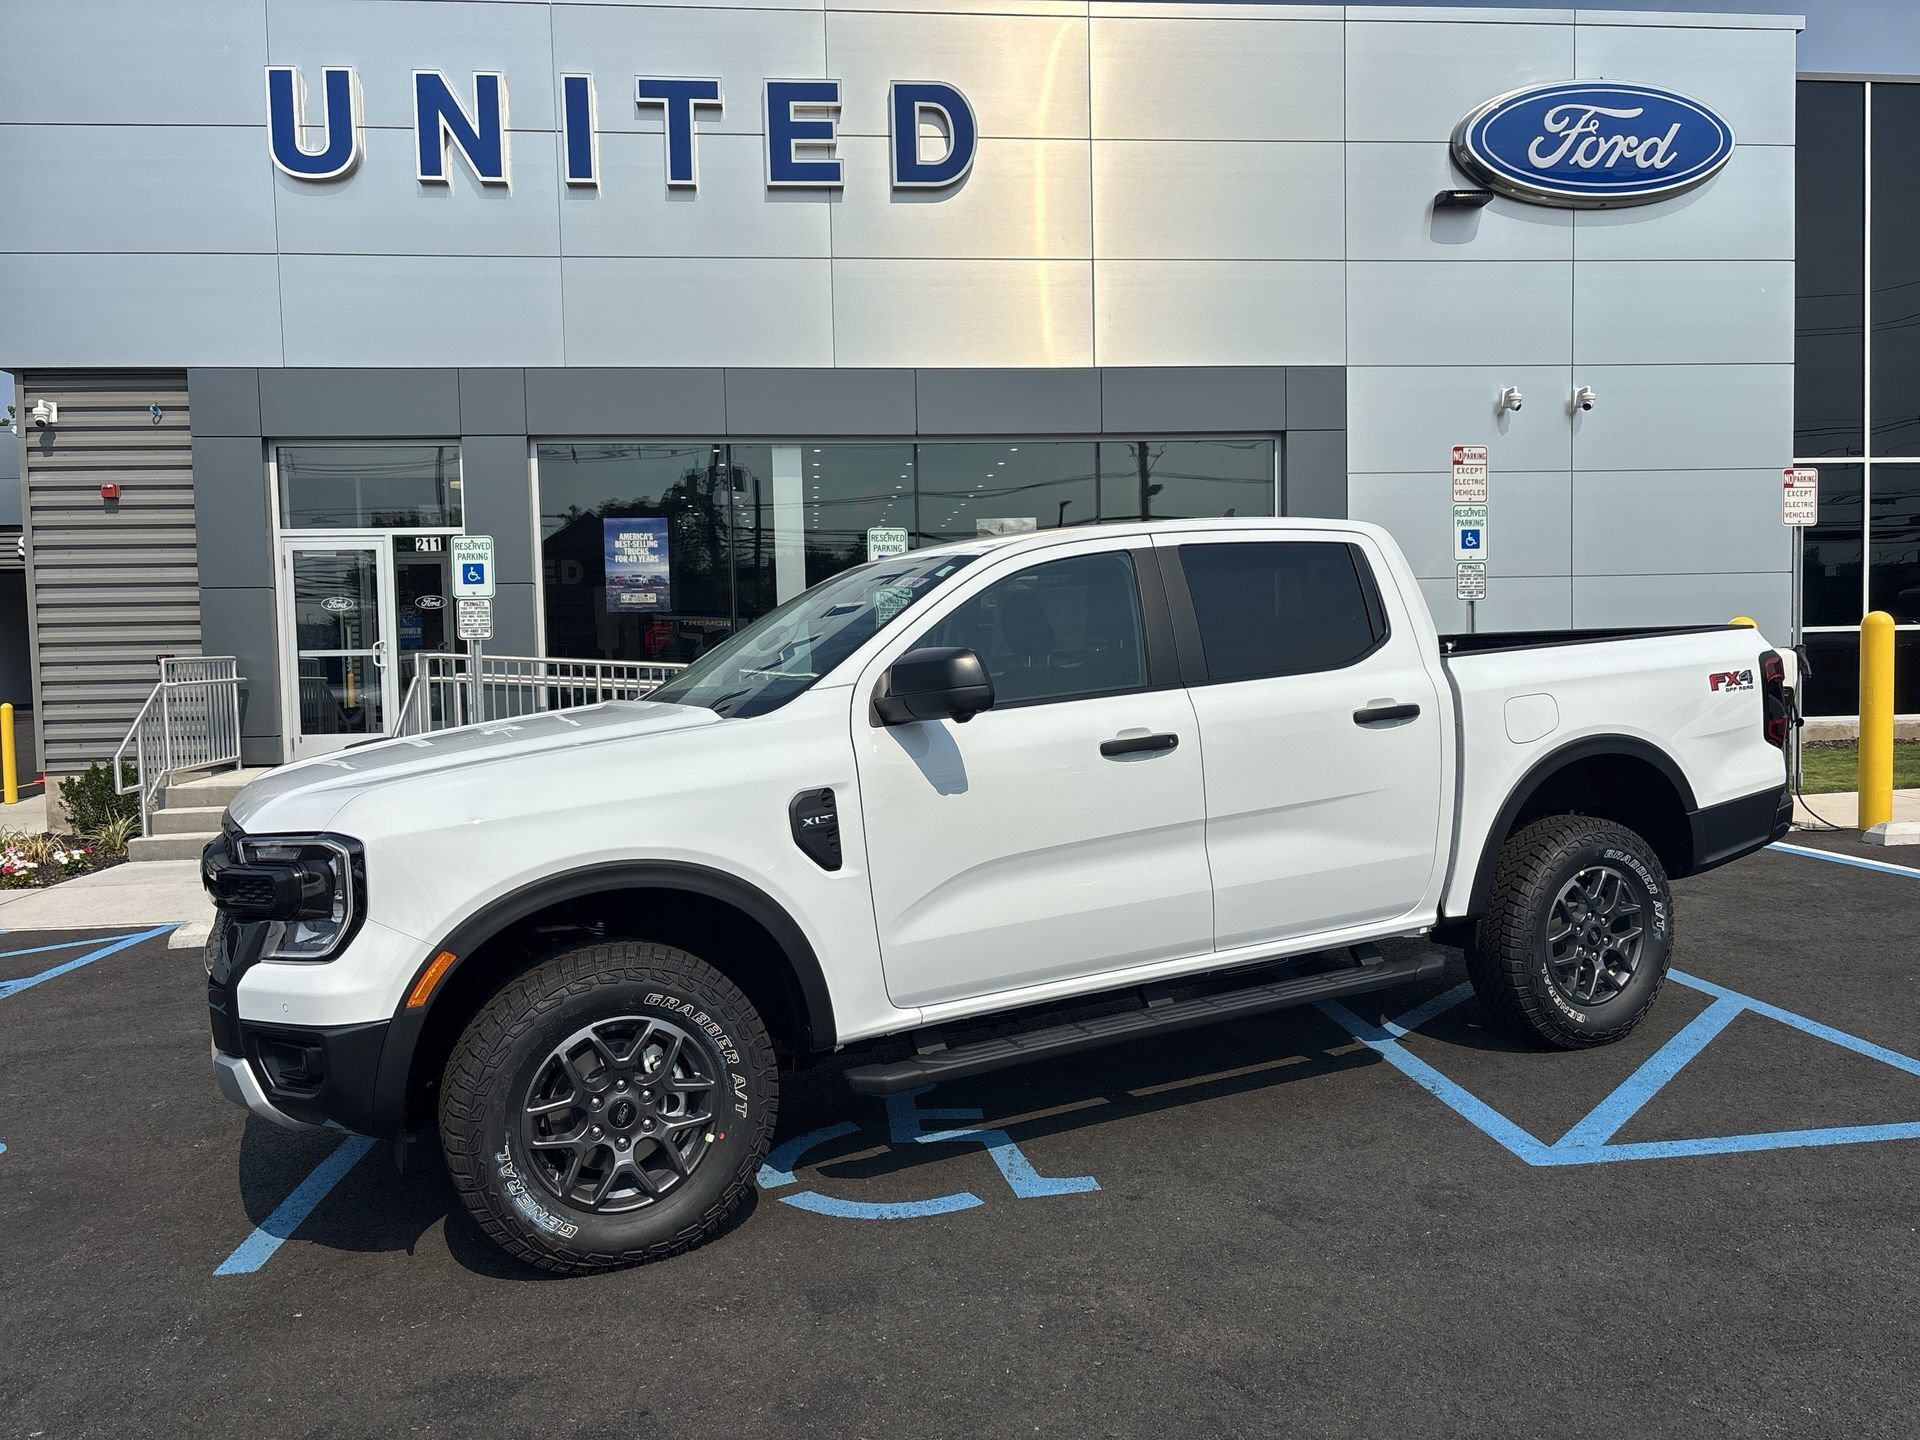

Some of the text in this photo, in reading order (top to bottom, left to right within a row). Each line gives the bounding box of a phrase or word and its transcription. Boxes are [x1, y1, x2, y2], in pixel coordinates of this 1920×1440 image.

[264, 66, 978, 188] UNITED
[1528, 103, 1681, 169] Ford
[1453, 450, 1486, 461] NO PARKING
[1456, 467, 1483, 475] EXCEPT
[1784, 473, 1794, 484] NO
[1454, 509, 1486, 517] RESERVED
[1456, 519, 1484, 527] PARKING
[871, 534, 904, 542] RESERVED
[416, 538, 440, 551] 211
[455, 542, 490, 550] RESERVED
[614, 540, 659, 548] BEST-SELLING
[873, 544, 902, 552] PARKING
[624, 547, 649, 555] TRUCKS
[457, 552, 488, 561] PARKING
[615, 555, 659, 563] FOR 49 YEARS
[327, 599, 347, 609] Ford
[420, 597, 441, 607] Ford
[1709, 669, 1753, 692] FX4
[802, 814, 834, 828] XLT
[1604, 849, 1665, 931] GRABBER A/T
[1541, 962, 1586, 1023] GENERAL
[643, 993, 748, 1118] GRABBER A/T
[497, 1145, 579, 1239] GENERAL
